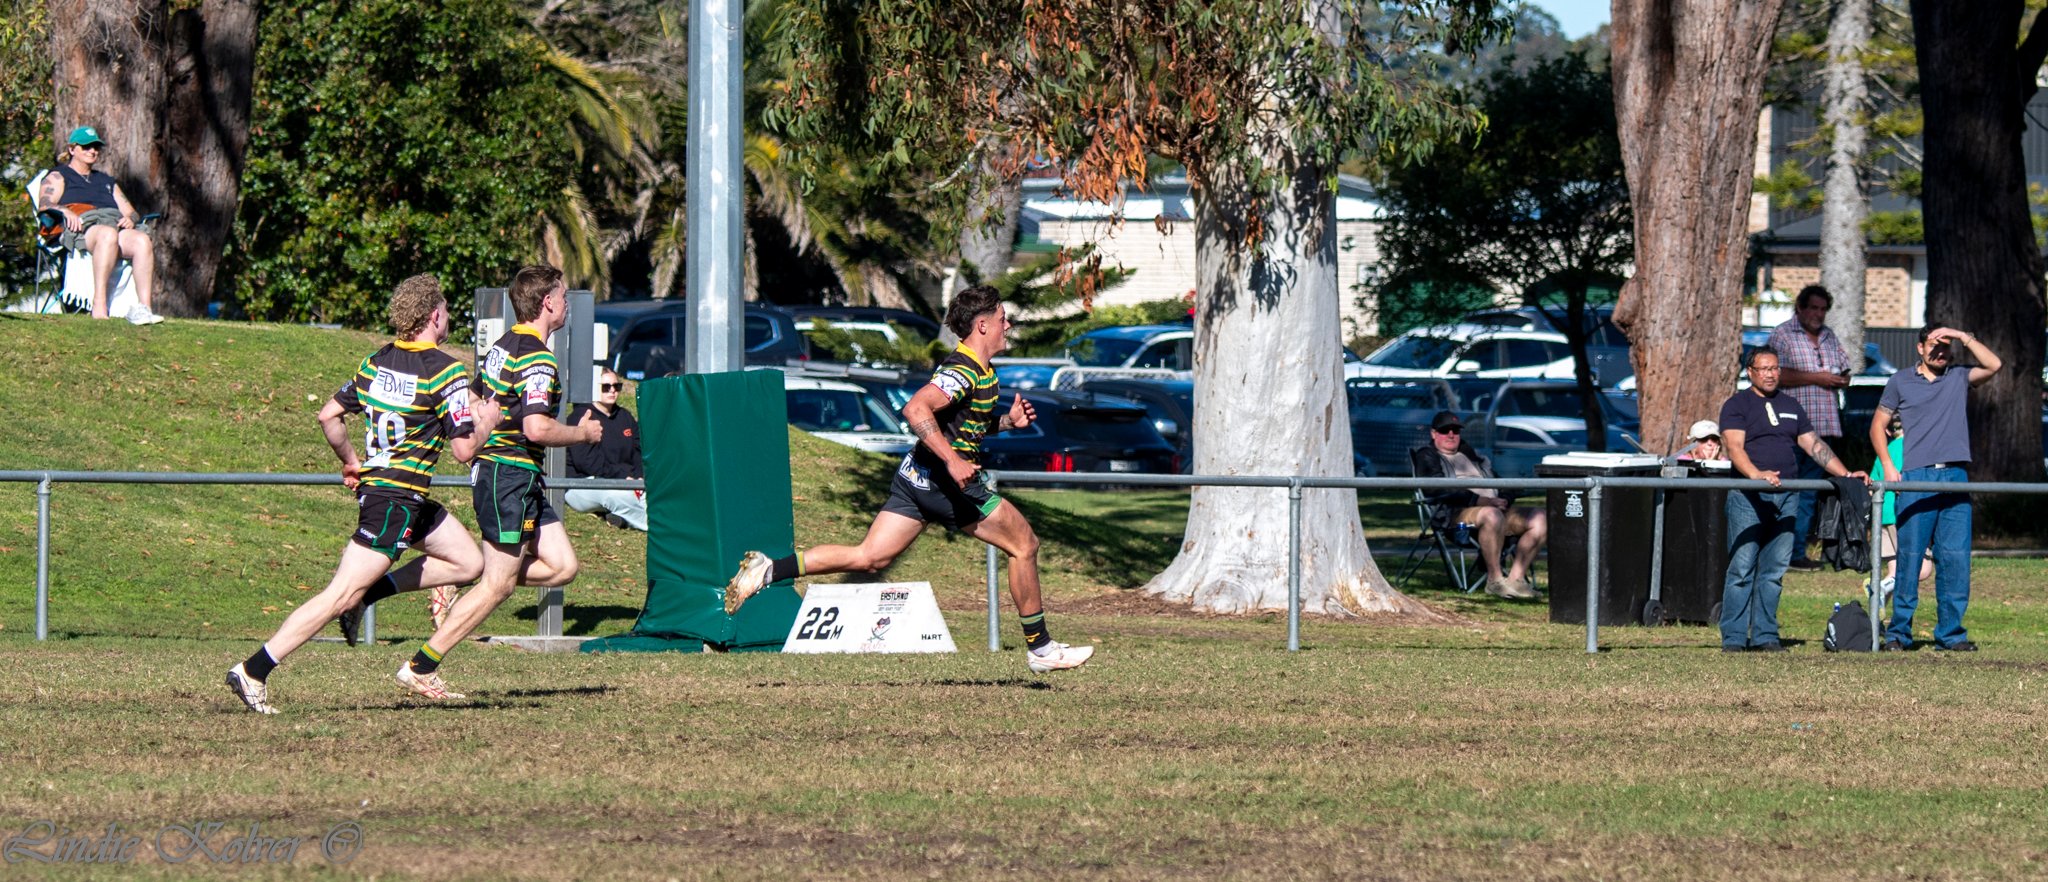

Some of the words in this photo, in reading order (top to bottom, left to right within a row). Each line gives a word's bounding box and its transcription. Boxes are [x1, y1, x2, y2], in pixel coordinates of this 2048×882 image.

[365, 404, 406, 456] 10
[880, 592, 909, 601] EASTLAND
[921, 633, 942, 641] HART
